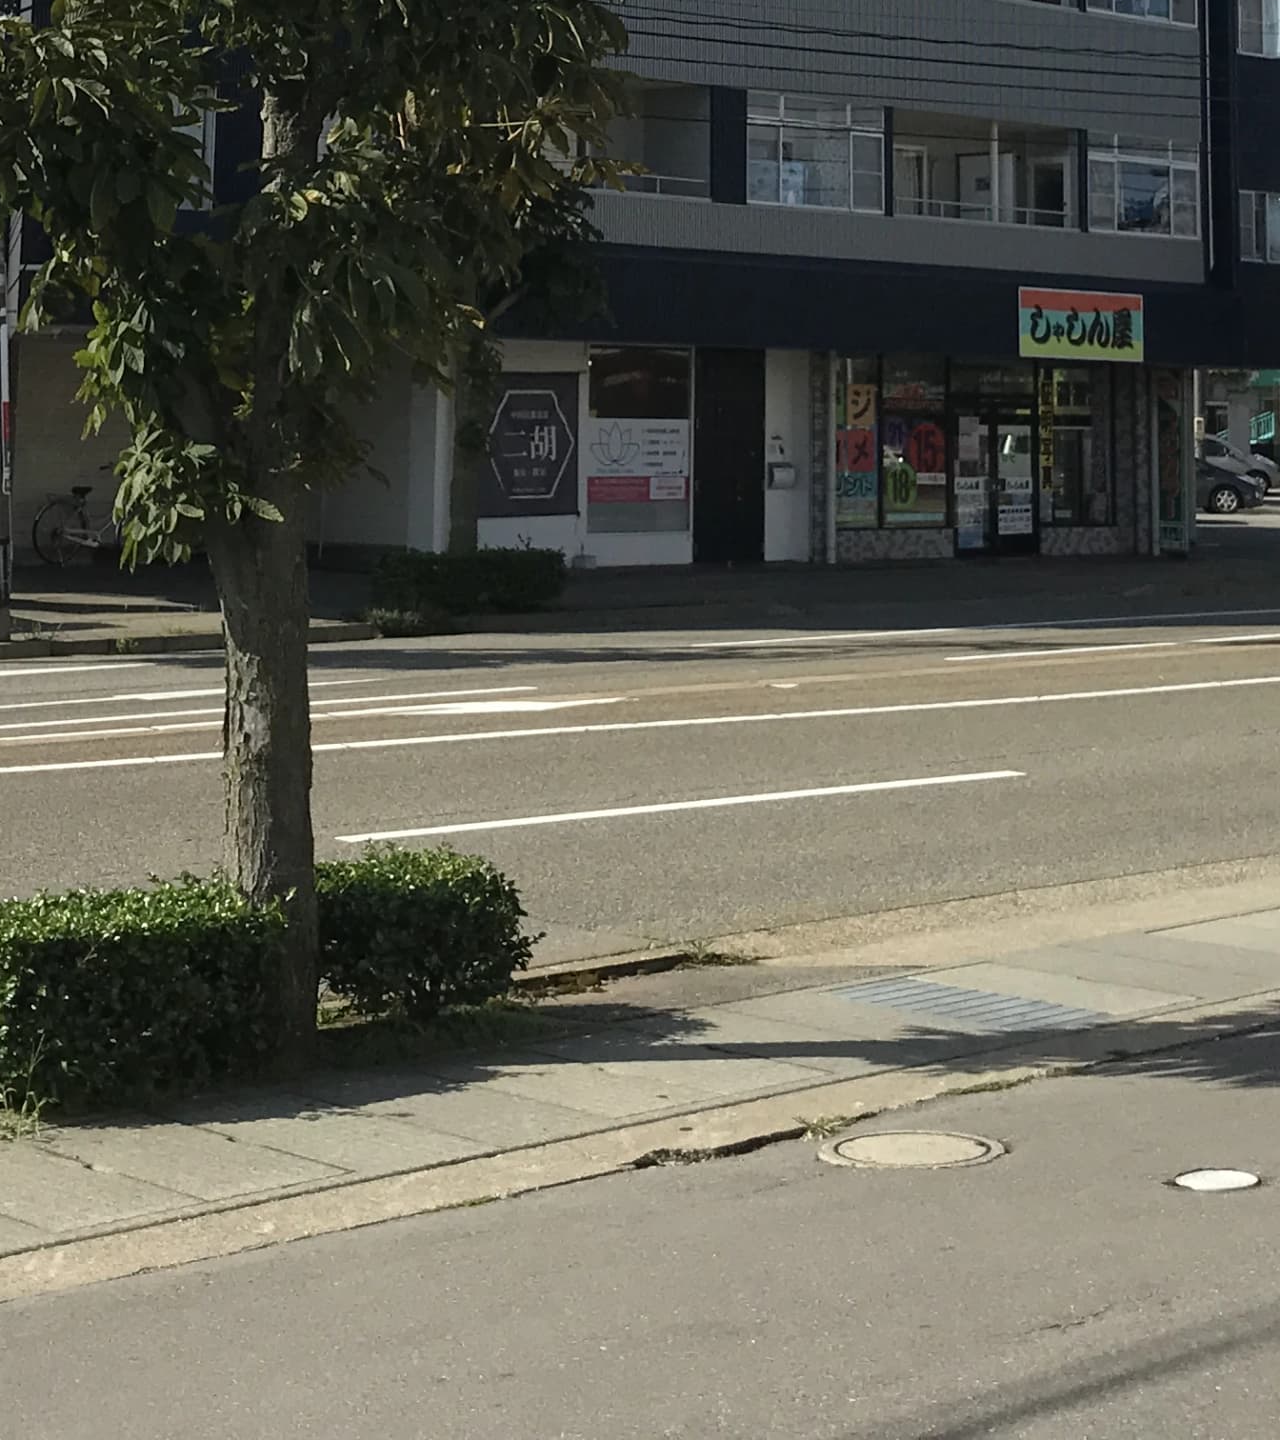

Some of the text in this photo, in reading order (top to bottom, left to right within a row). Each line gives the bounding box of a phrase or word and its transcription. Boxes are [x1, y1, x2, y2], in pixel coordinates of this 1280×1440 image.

[1030, 304, 1134, 349] しゃしん屋
[503, 426, 556, 460] 二胡
